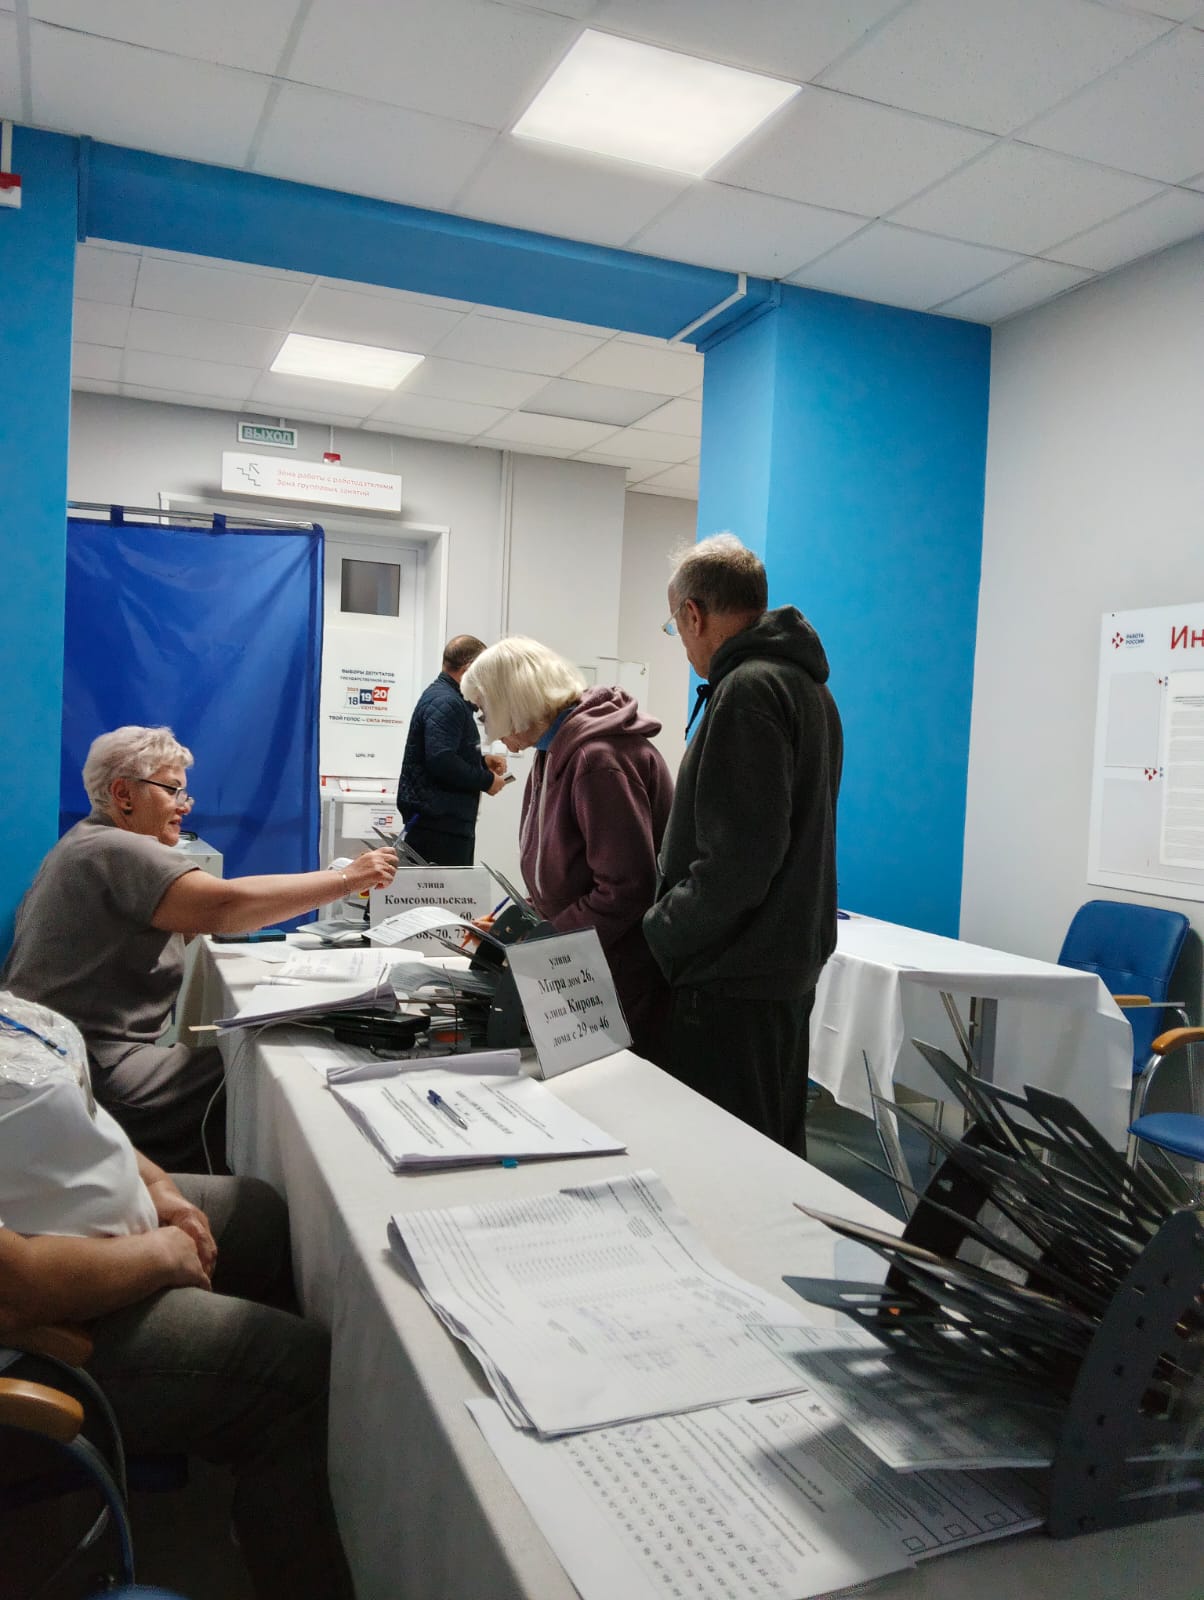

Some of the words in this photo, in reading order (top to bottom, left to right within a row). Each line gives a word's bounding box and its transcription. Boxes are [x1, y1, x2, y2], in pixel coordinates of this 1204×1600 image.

[244, 427, 292, 444] ВЫХОД
[348, 696, 359, 705] 18
[361, 692, 372, 702] 19
[374, 689, 387, 699] 20
[417, 882, 445, 890] улица
[549, 954, 571, 969] улица
[538, 978, 567, 994] Мира
[568, 974, 581, 988] дом
[580, 968, 595, 984] 26,
[544, 1006, 568, 1024] улица
[567, 995, 604, 1014] Кирова,
[554, 1031, 572, 1048] дома
[577, 1021, 588, 1038] 29
[589, 1023, 599, 1034] по
[599, 1014, 610, 1030] 46
